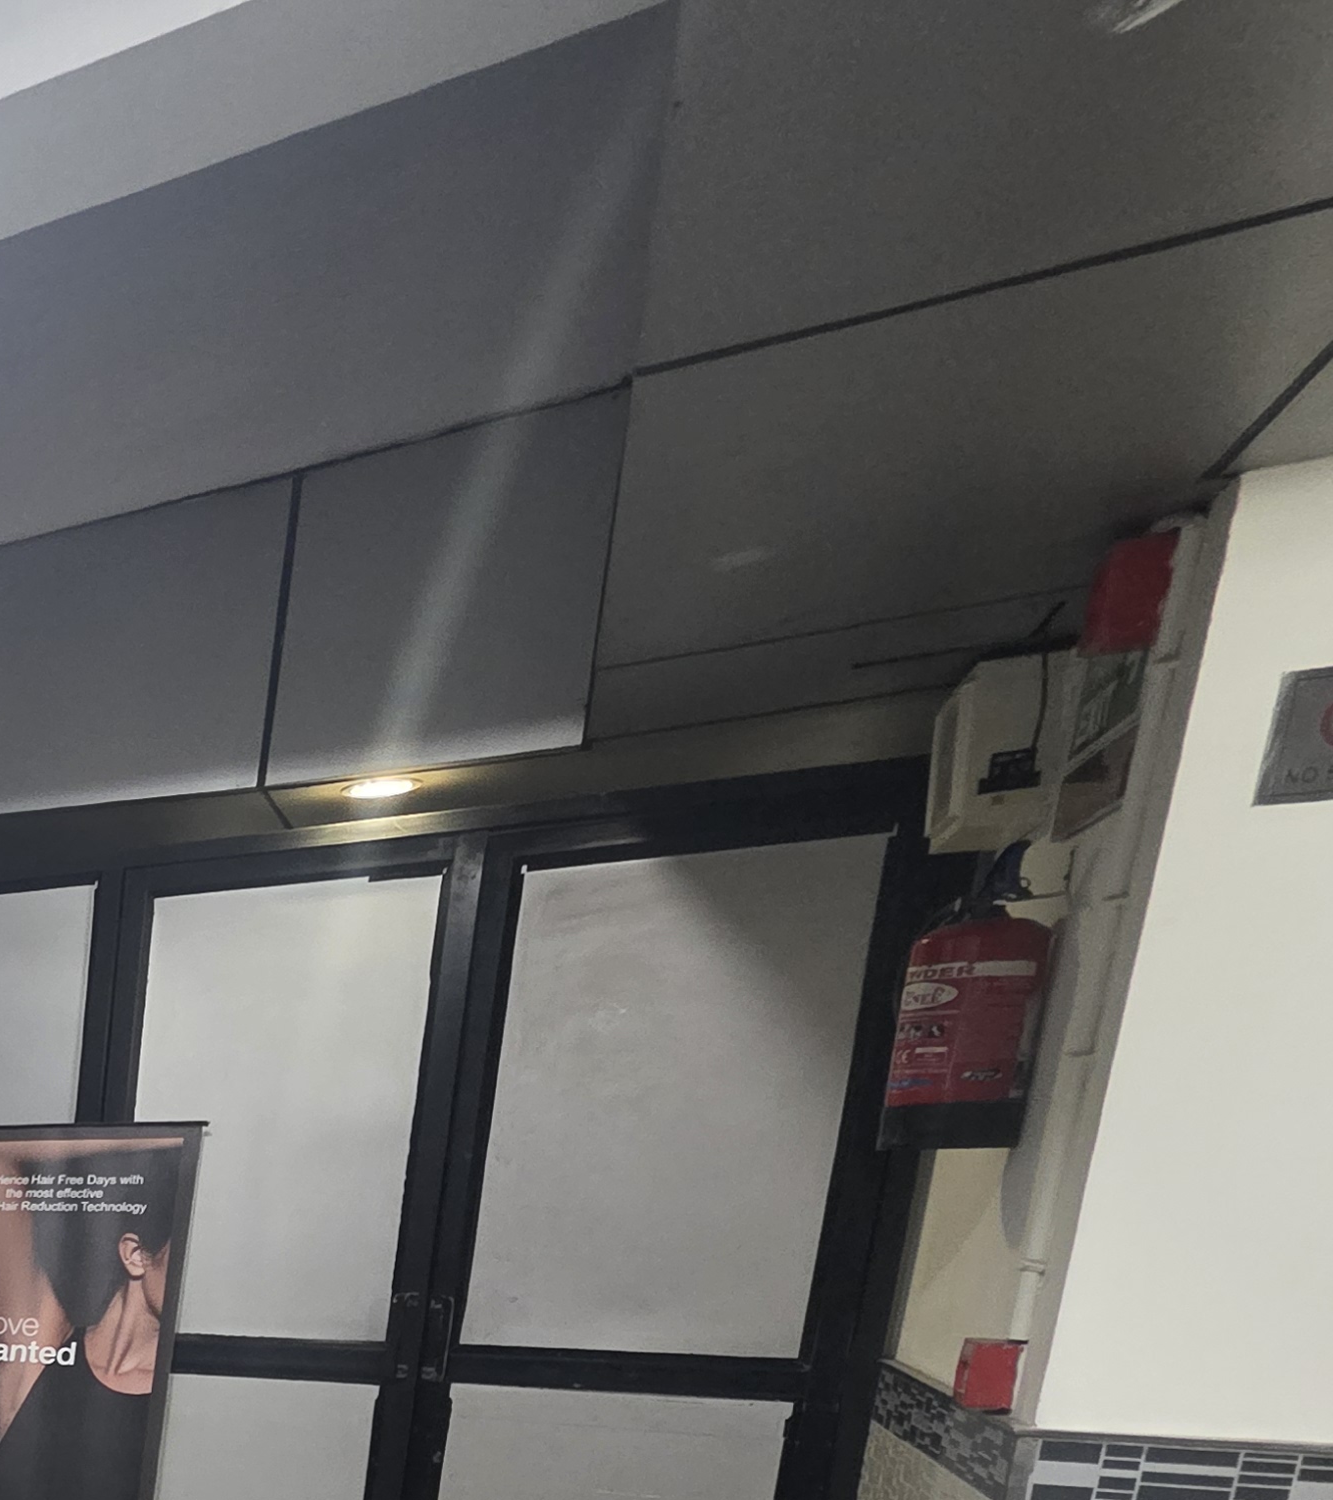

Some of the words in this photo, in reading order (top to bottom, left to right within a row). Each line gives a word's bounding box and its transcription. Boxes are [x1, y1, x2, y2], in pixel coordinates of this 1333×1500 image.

[30, 1174, 55, 1186] Hair
[57, 1174, 84, 1186] Free
[86, 1174, 117, 1188] Days
[119, 1174, 145, 1186] with
[5, 1188, 23, 1199] the
[25, 1189, 55, 1199] most
[56, 1188, 104, 1199] effective
[20, 1201, 78, 1212] Reduction
[81, 1201, 148, 1215] Technology
